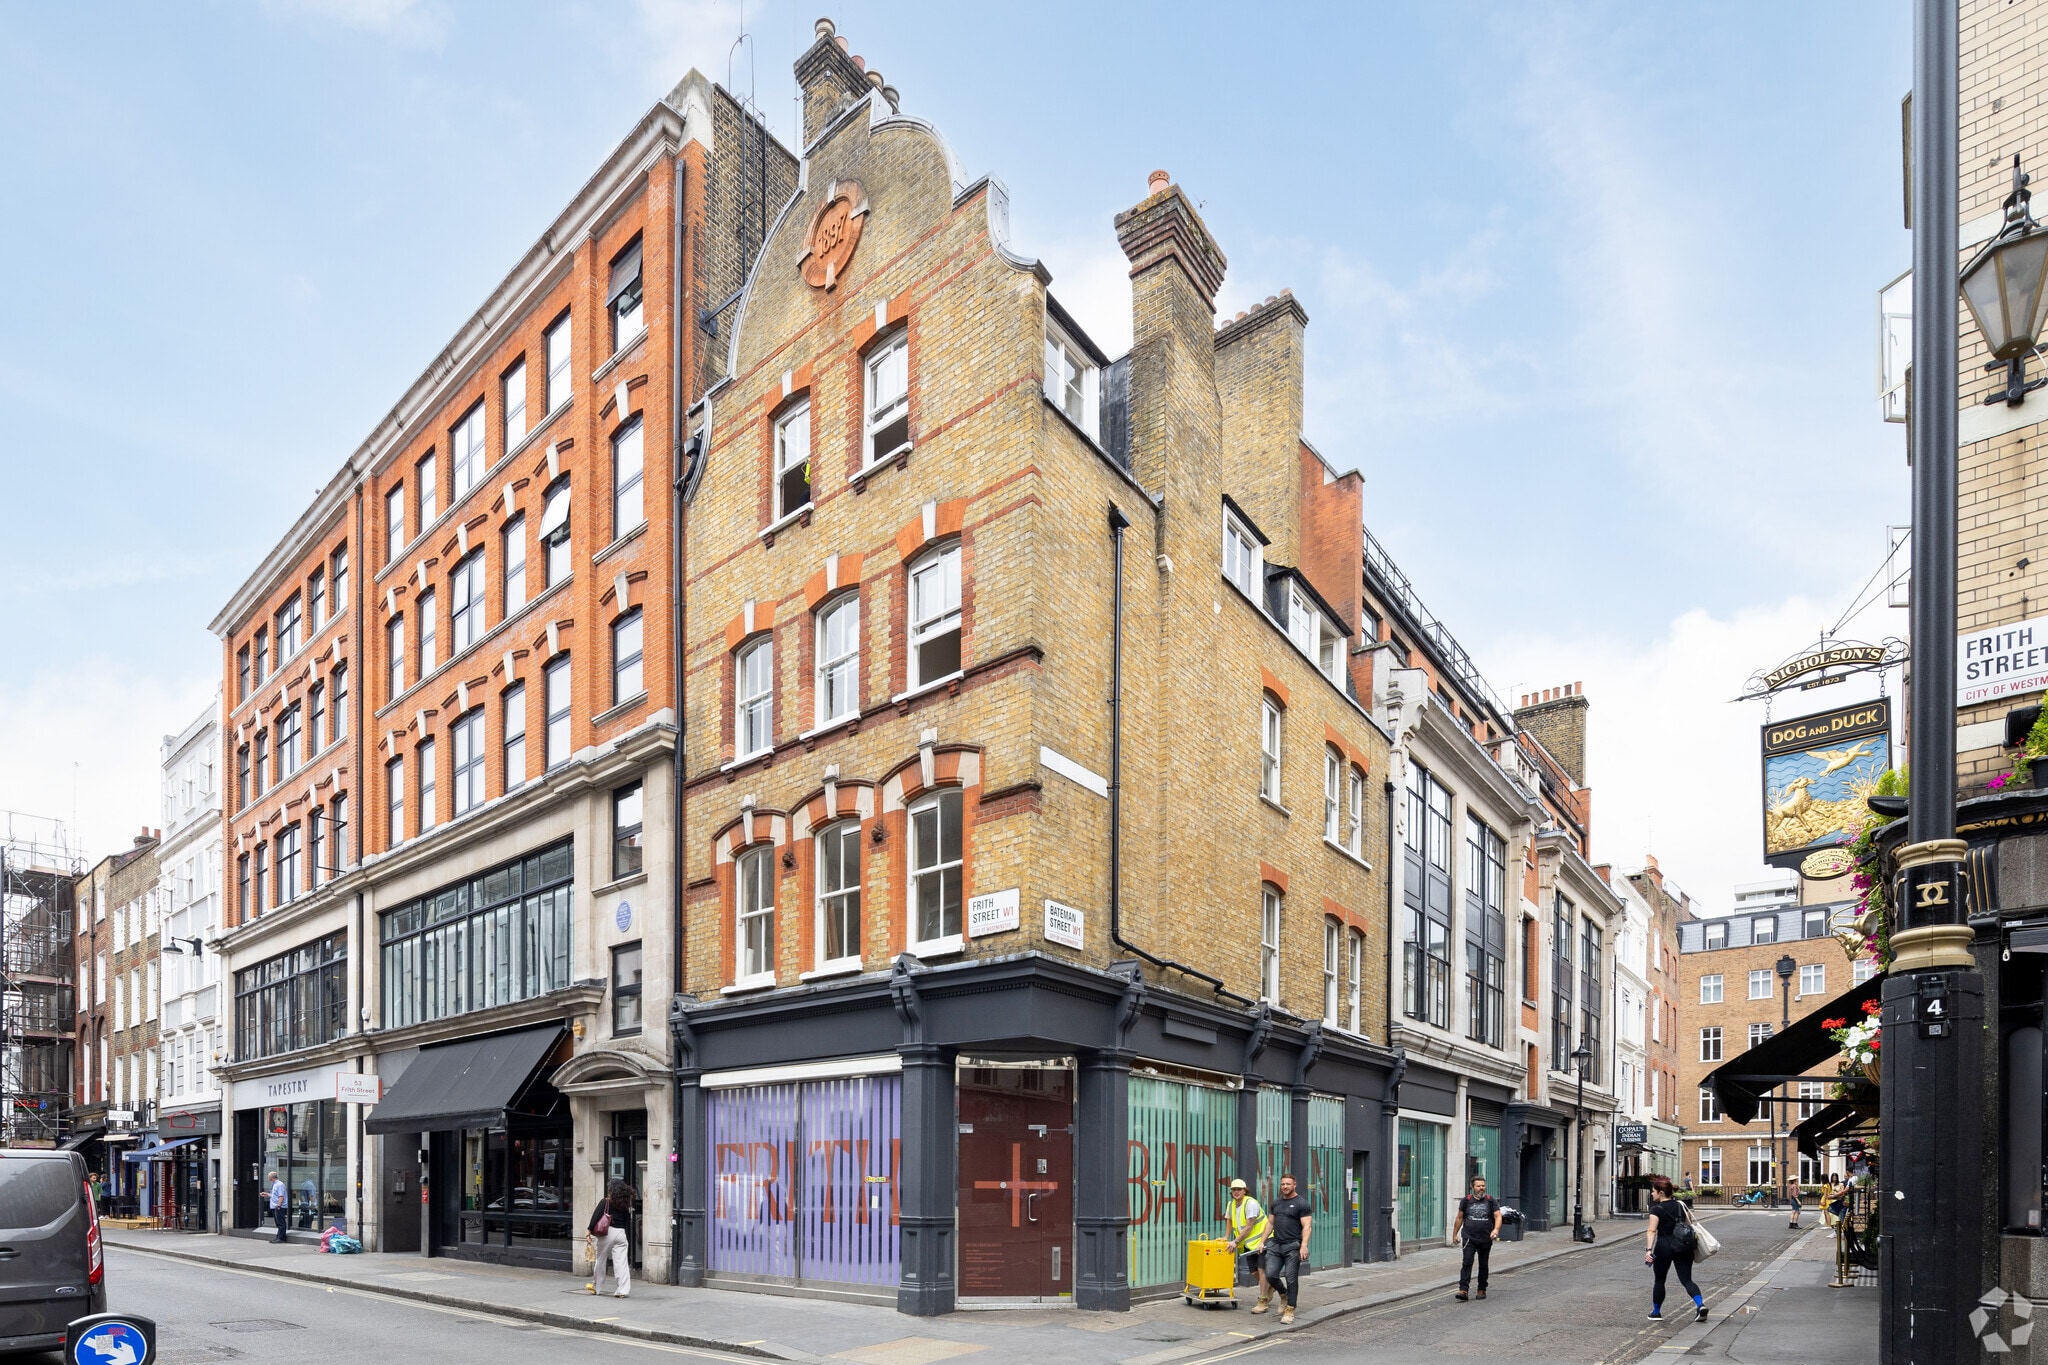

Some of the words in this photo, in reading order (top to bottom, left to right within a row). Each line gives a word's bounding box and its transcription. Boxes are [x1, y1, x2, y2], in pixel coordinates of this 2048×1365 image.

[1966, 627, 2032, 659] FRITH
[1766, 648, 1882, 685] NICHOLSON'S
[1965, 688, 1989, 700] CITY
[1993, 684, 2006, 695] OF
[1772, 725, 1807, 746] DOG
[1808, 725, 1829, 737] AND
[1831, 708, 1878, 731] DUCK
[972, 898, 994, 911] FRITH
[972, 909, 1001, 924] STREET
[1003, 906, 1014, 917] W1
[1050, 905, 1077, 922] BATEMAN
[1050, 917, 1071, 932] STREET
[1072, 925, 1081, 937] W1
[1927, 999, 1943, 1016] 4
[268, 1080, 308, 1097] TAPESTRY
[357, 1086, 376, 1094] Street
[715, 1137, 902, 1227] FRITH
